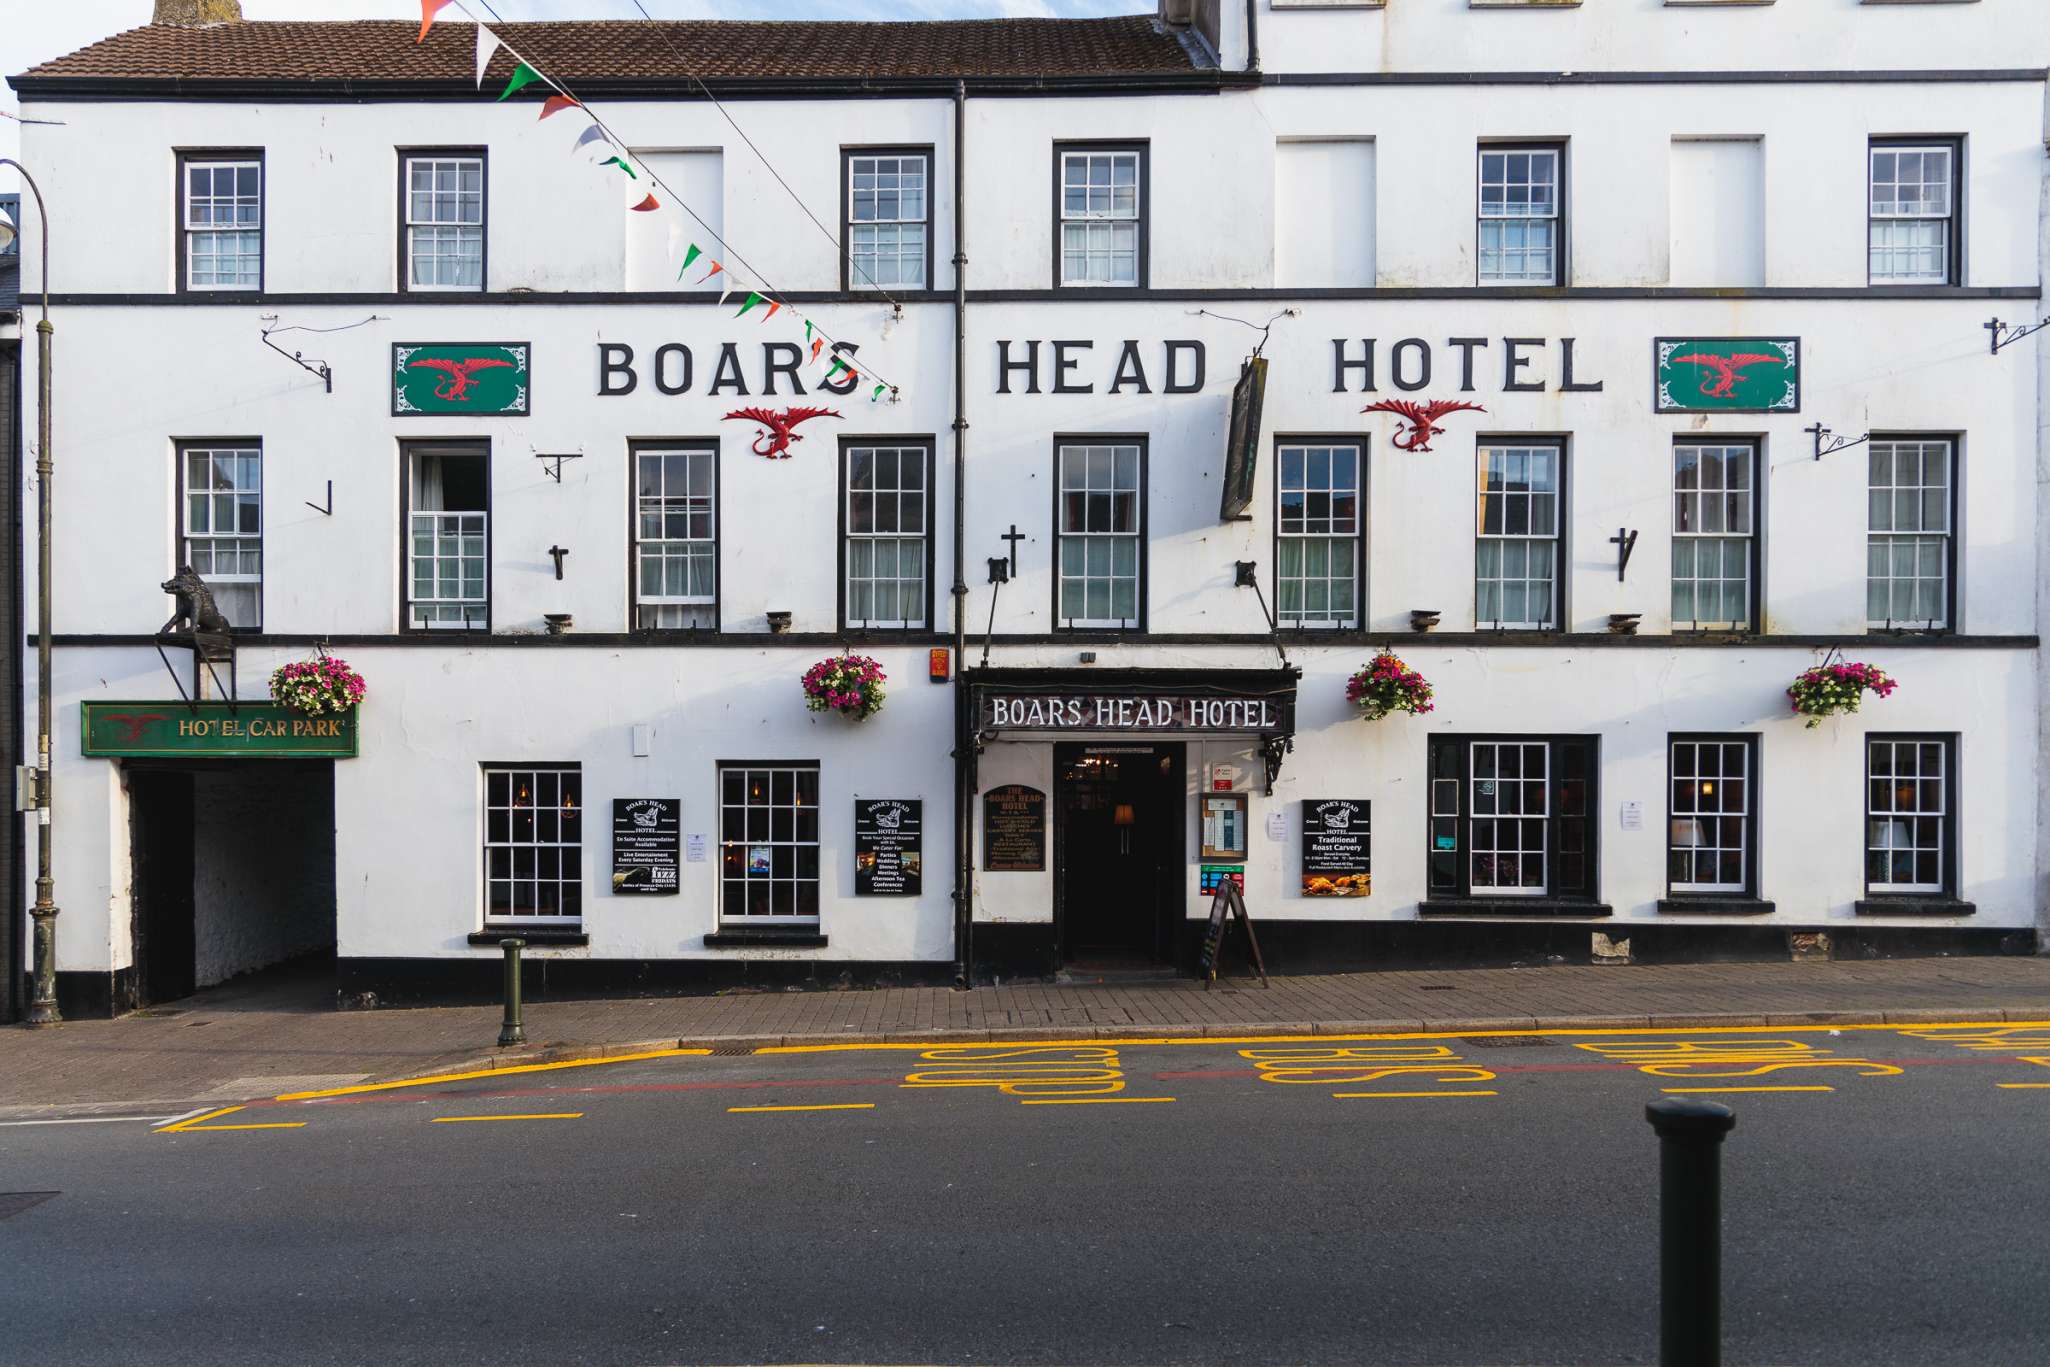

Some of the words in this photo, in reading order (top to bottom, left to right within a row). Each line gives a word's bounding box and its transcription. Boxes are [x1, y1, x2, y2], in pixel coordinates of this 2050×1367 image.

[597, 342, 860, 396] BOARS
[996, 340, 1206, 394] HEAD
[1332, 337, 1603, 393] HOTEL
[992, 699, 1082, 726] BOARS
[1096, 699, 1173, 727] HEAD
[1190, 700, 1276, 727] HOTEL
[179, 720, 245, 737] HOTEL
[250, 719, 286, 737] CAR
[292, 719, 342, 737] PARK
[649, 800, 667, 811] HEAD
[891, 801, 910, 813] HEAD
[1340, 801, 1359, 813] HEAD
[1333, 844, 1362, 852] Carvery
[898, 1047, 1126, 1096] STOP
[1236, 1046, 1497, 1084] BUS
